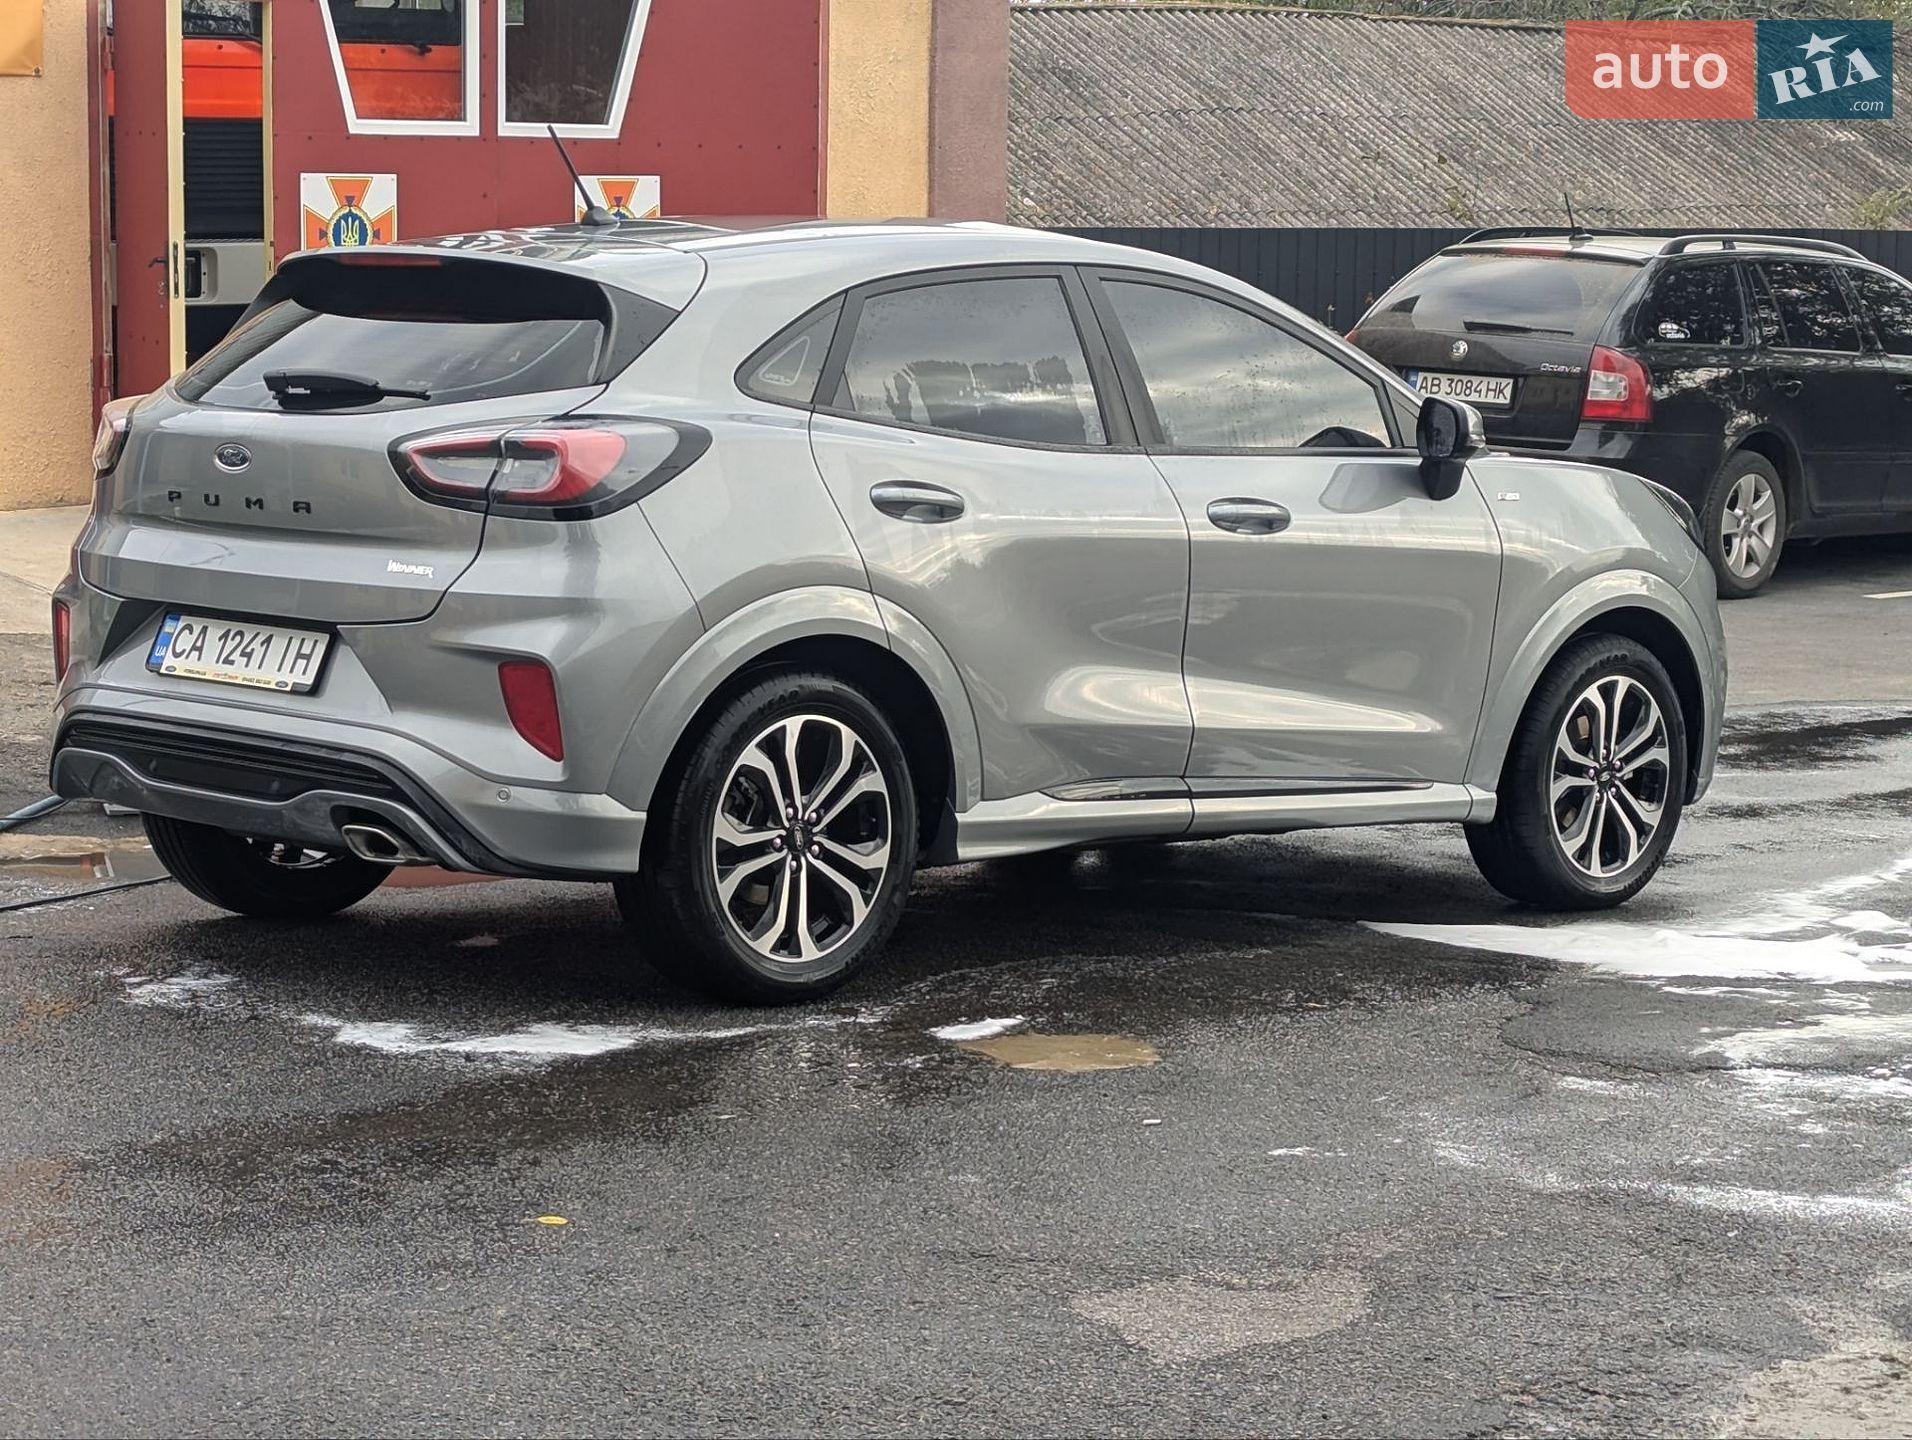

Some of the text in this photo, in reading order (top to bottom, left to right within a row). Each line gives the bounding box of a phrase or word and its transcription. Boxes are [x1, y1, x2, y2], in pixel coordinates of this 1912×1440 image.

[1419, 376, 1511, 400] AB 3084 HK
[168, 490, 312, 514] PUMA
[171, 623, 319, 676] CA 1241 IH
